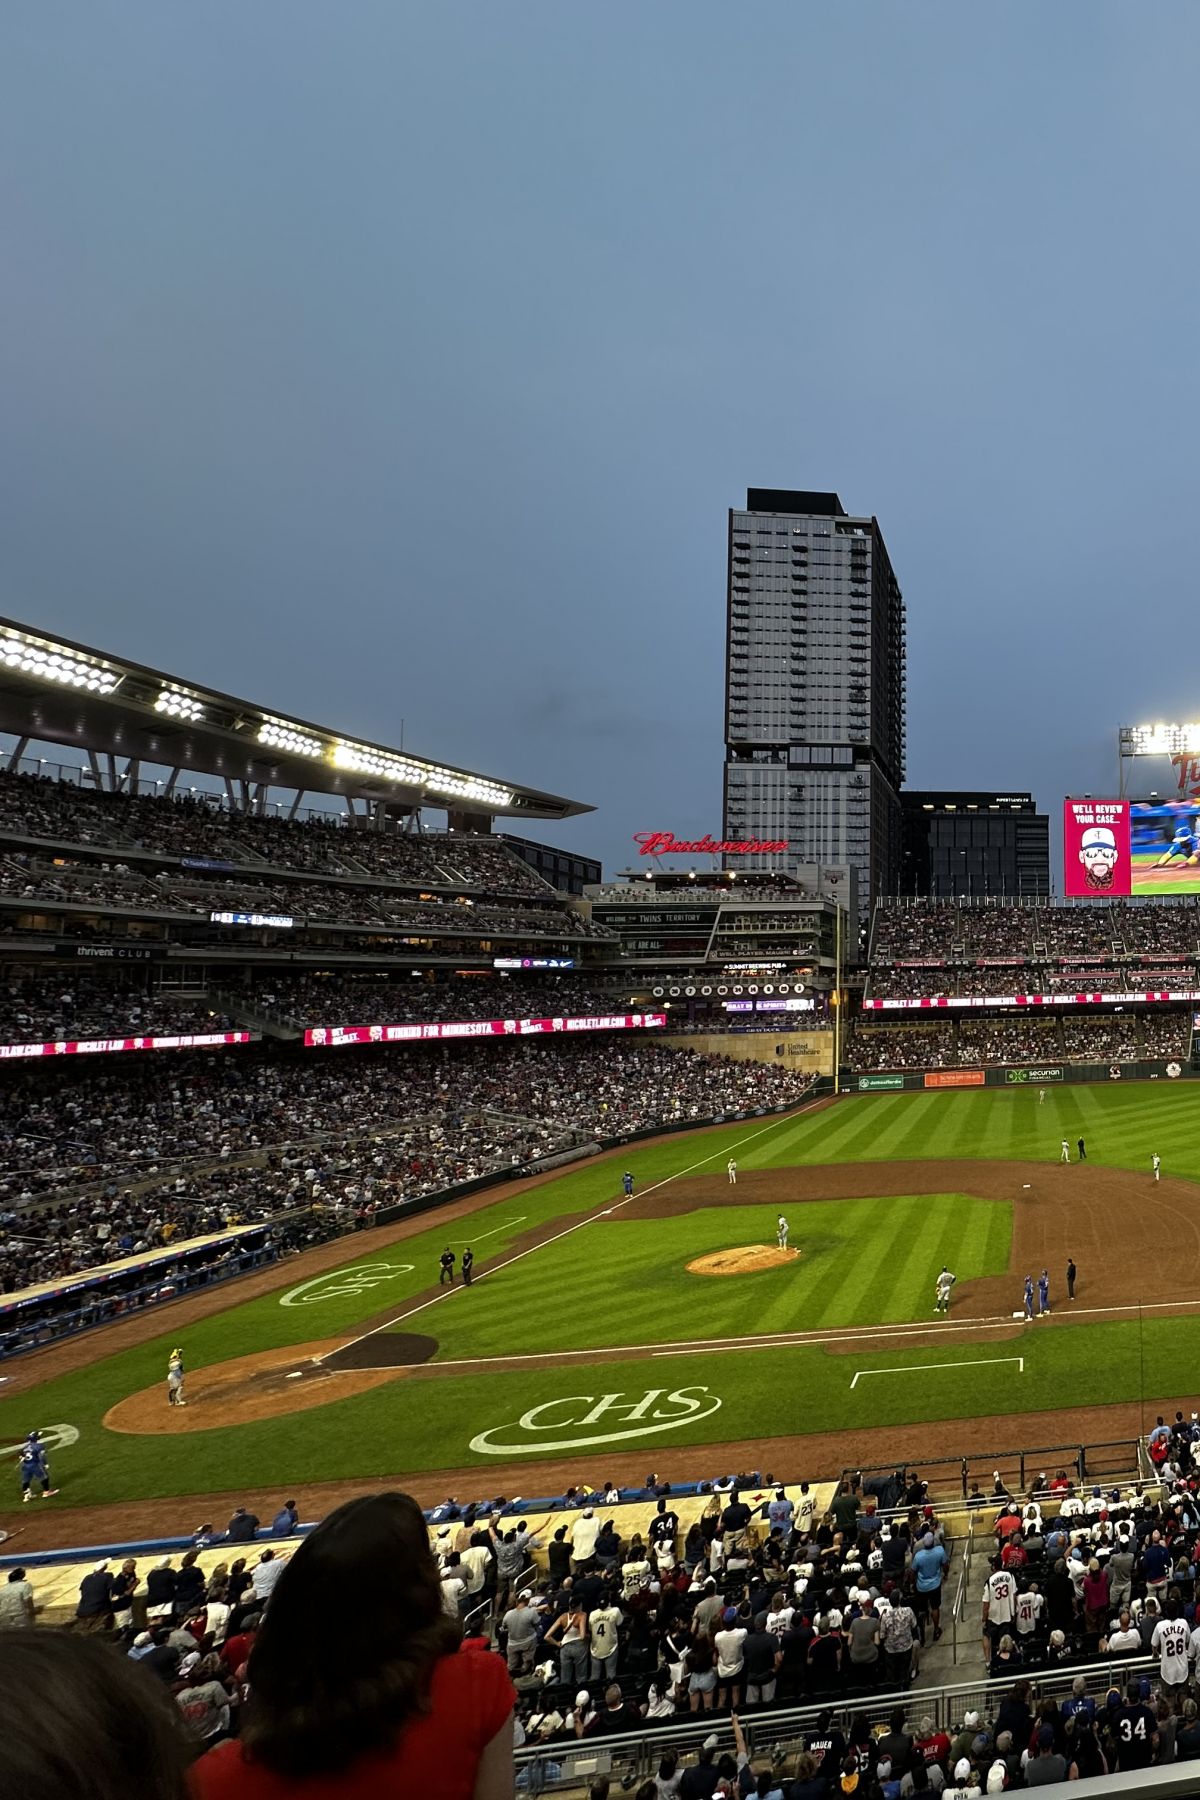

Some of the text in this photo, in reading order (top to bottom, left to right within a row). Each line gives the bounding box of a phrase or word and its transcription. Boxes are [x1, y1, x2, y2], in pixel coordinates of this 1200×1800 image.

[1072, 805, 1123, 814] WE'LL REVIEW
[1075, 815, 1094, 823] YOUR
[632, 832, 790, 856] Budweiser
[640, 914, 662, 923] TWINS
[666, 914, 700, 922] TERRITORY
[77, 947, 150, 958] thrivent CLUB
[1029, 1069, 1060, 1077] securian
[518, 1386, 710, 1431] CHS
[772, 1512, 786, 1521] 34
[801, 1505, 813, 1517] 23
[626, 1575, 640, 1586] 25
[995, 1584, 1009, 1600] 33
[1020, 1606, 1032, 1620] 41
[596, 1623, 605, 1637] 4
[1163, 1625, 1185, 1638] KEPLER
[1166, 1638, 1184, 1657] 26
[1120, 1716, 1147, 1742] 34
[811, 1740, 832, 1751] MAUER
